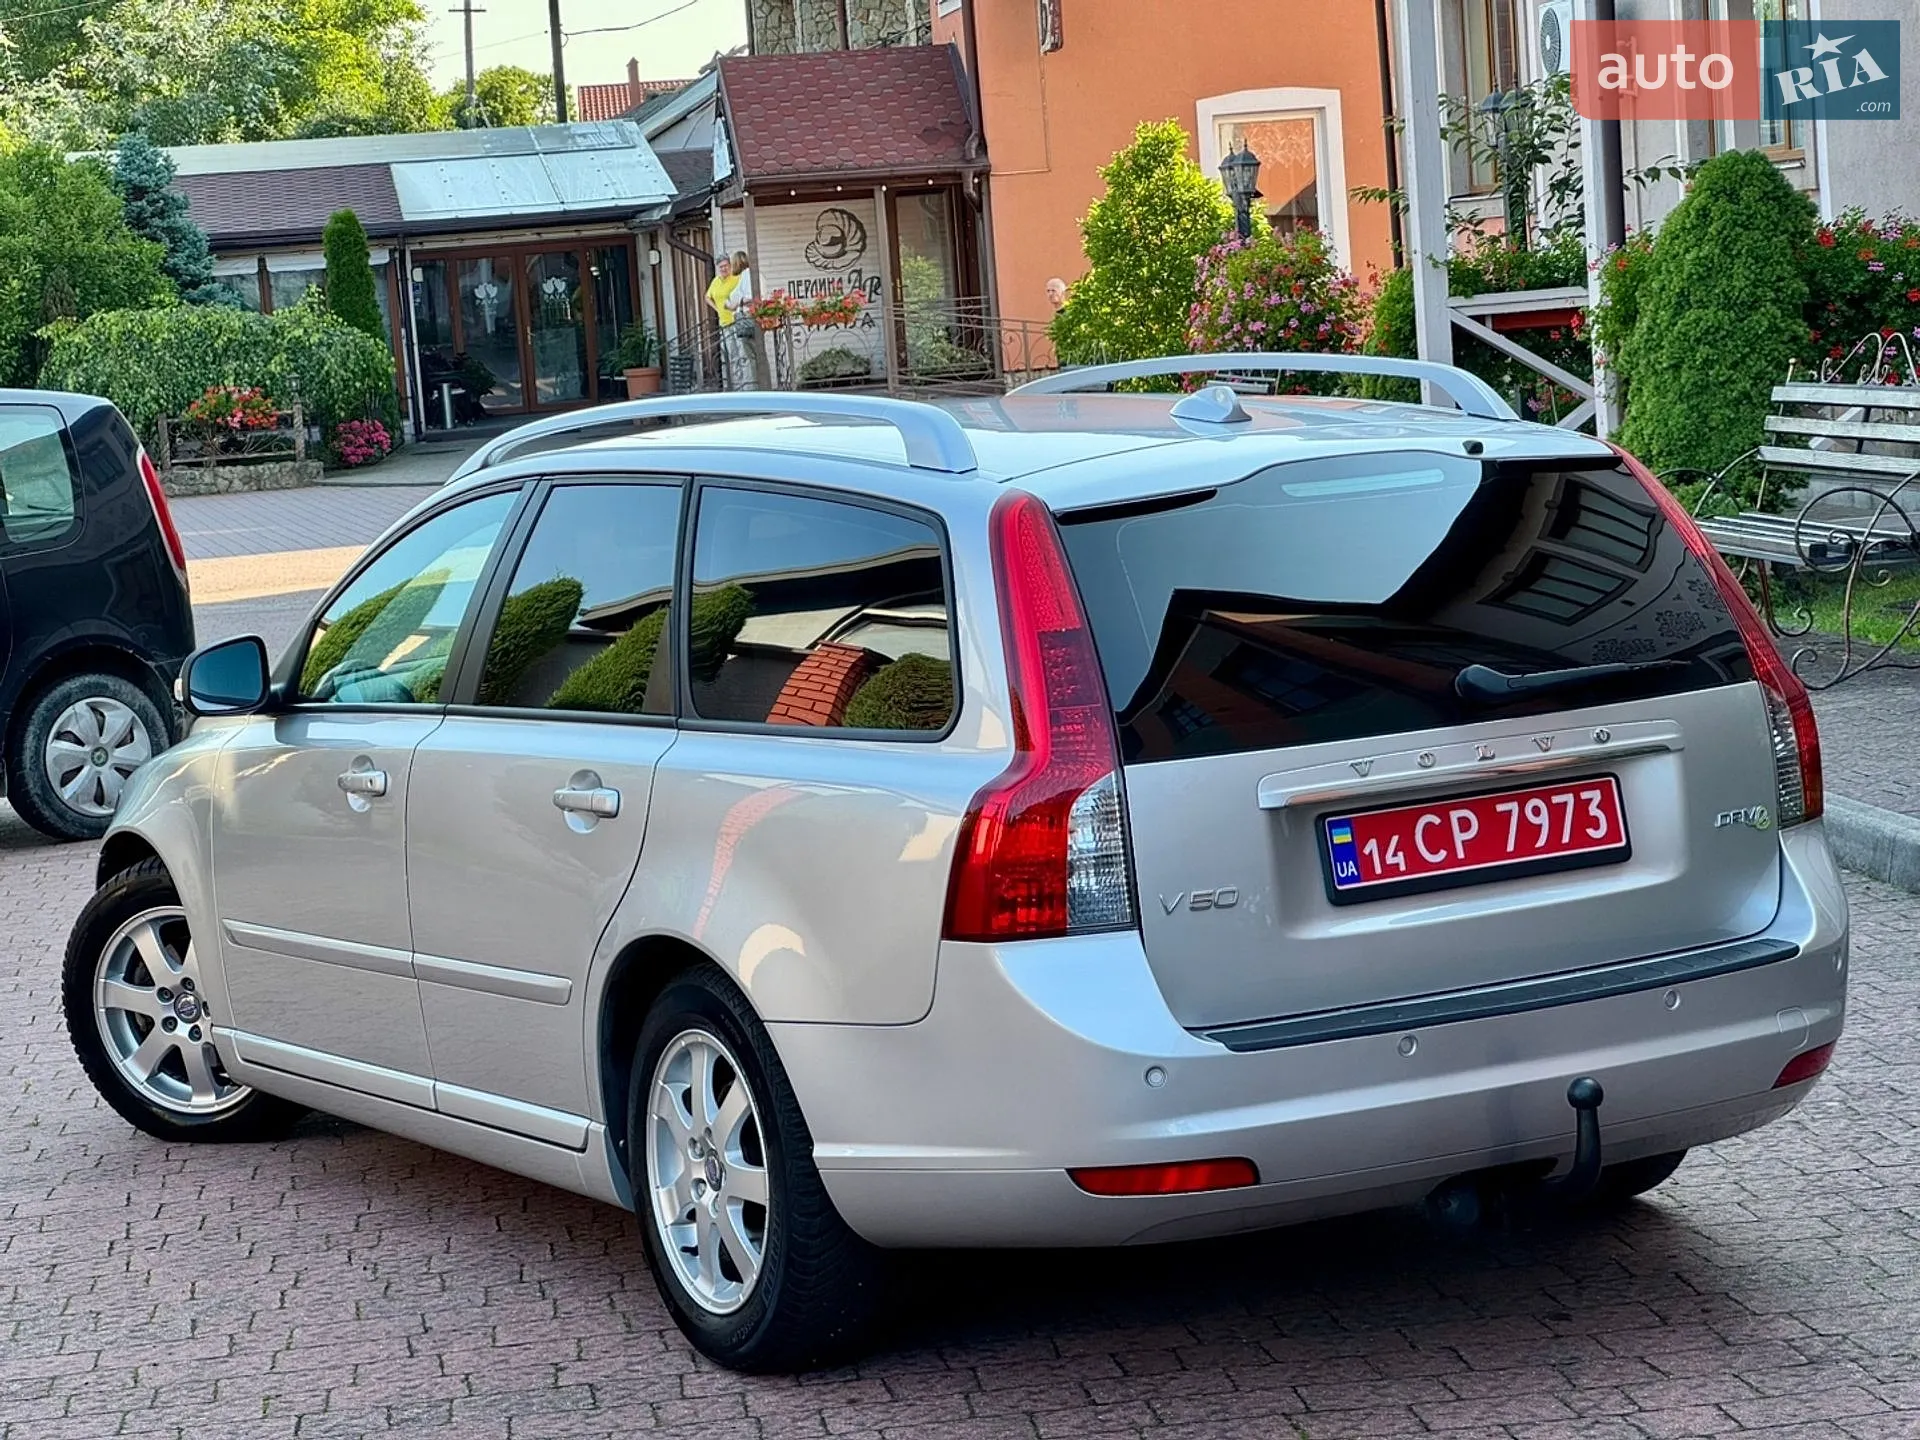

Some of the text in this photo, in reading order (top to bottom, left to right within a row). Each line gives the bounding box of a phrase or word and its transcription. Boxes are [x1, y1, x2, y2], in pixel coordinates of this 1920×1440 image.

[1350, 727, 1612, 777] VOLVO
[1362, 789, 1608, 875] 14 CP 7973
[1337, 861, 1358, 878] UA
[1159, 886, 1239, 916] V50
